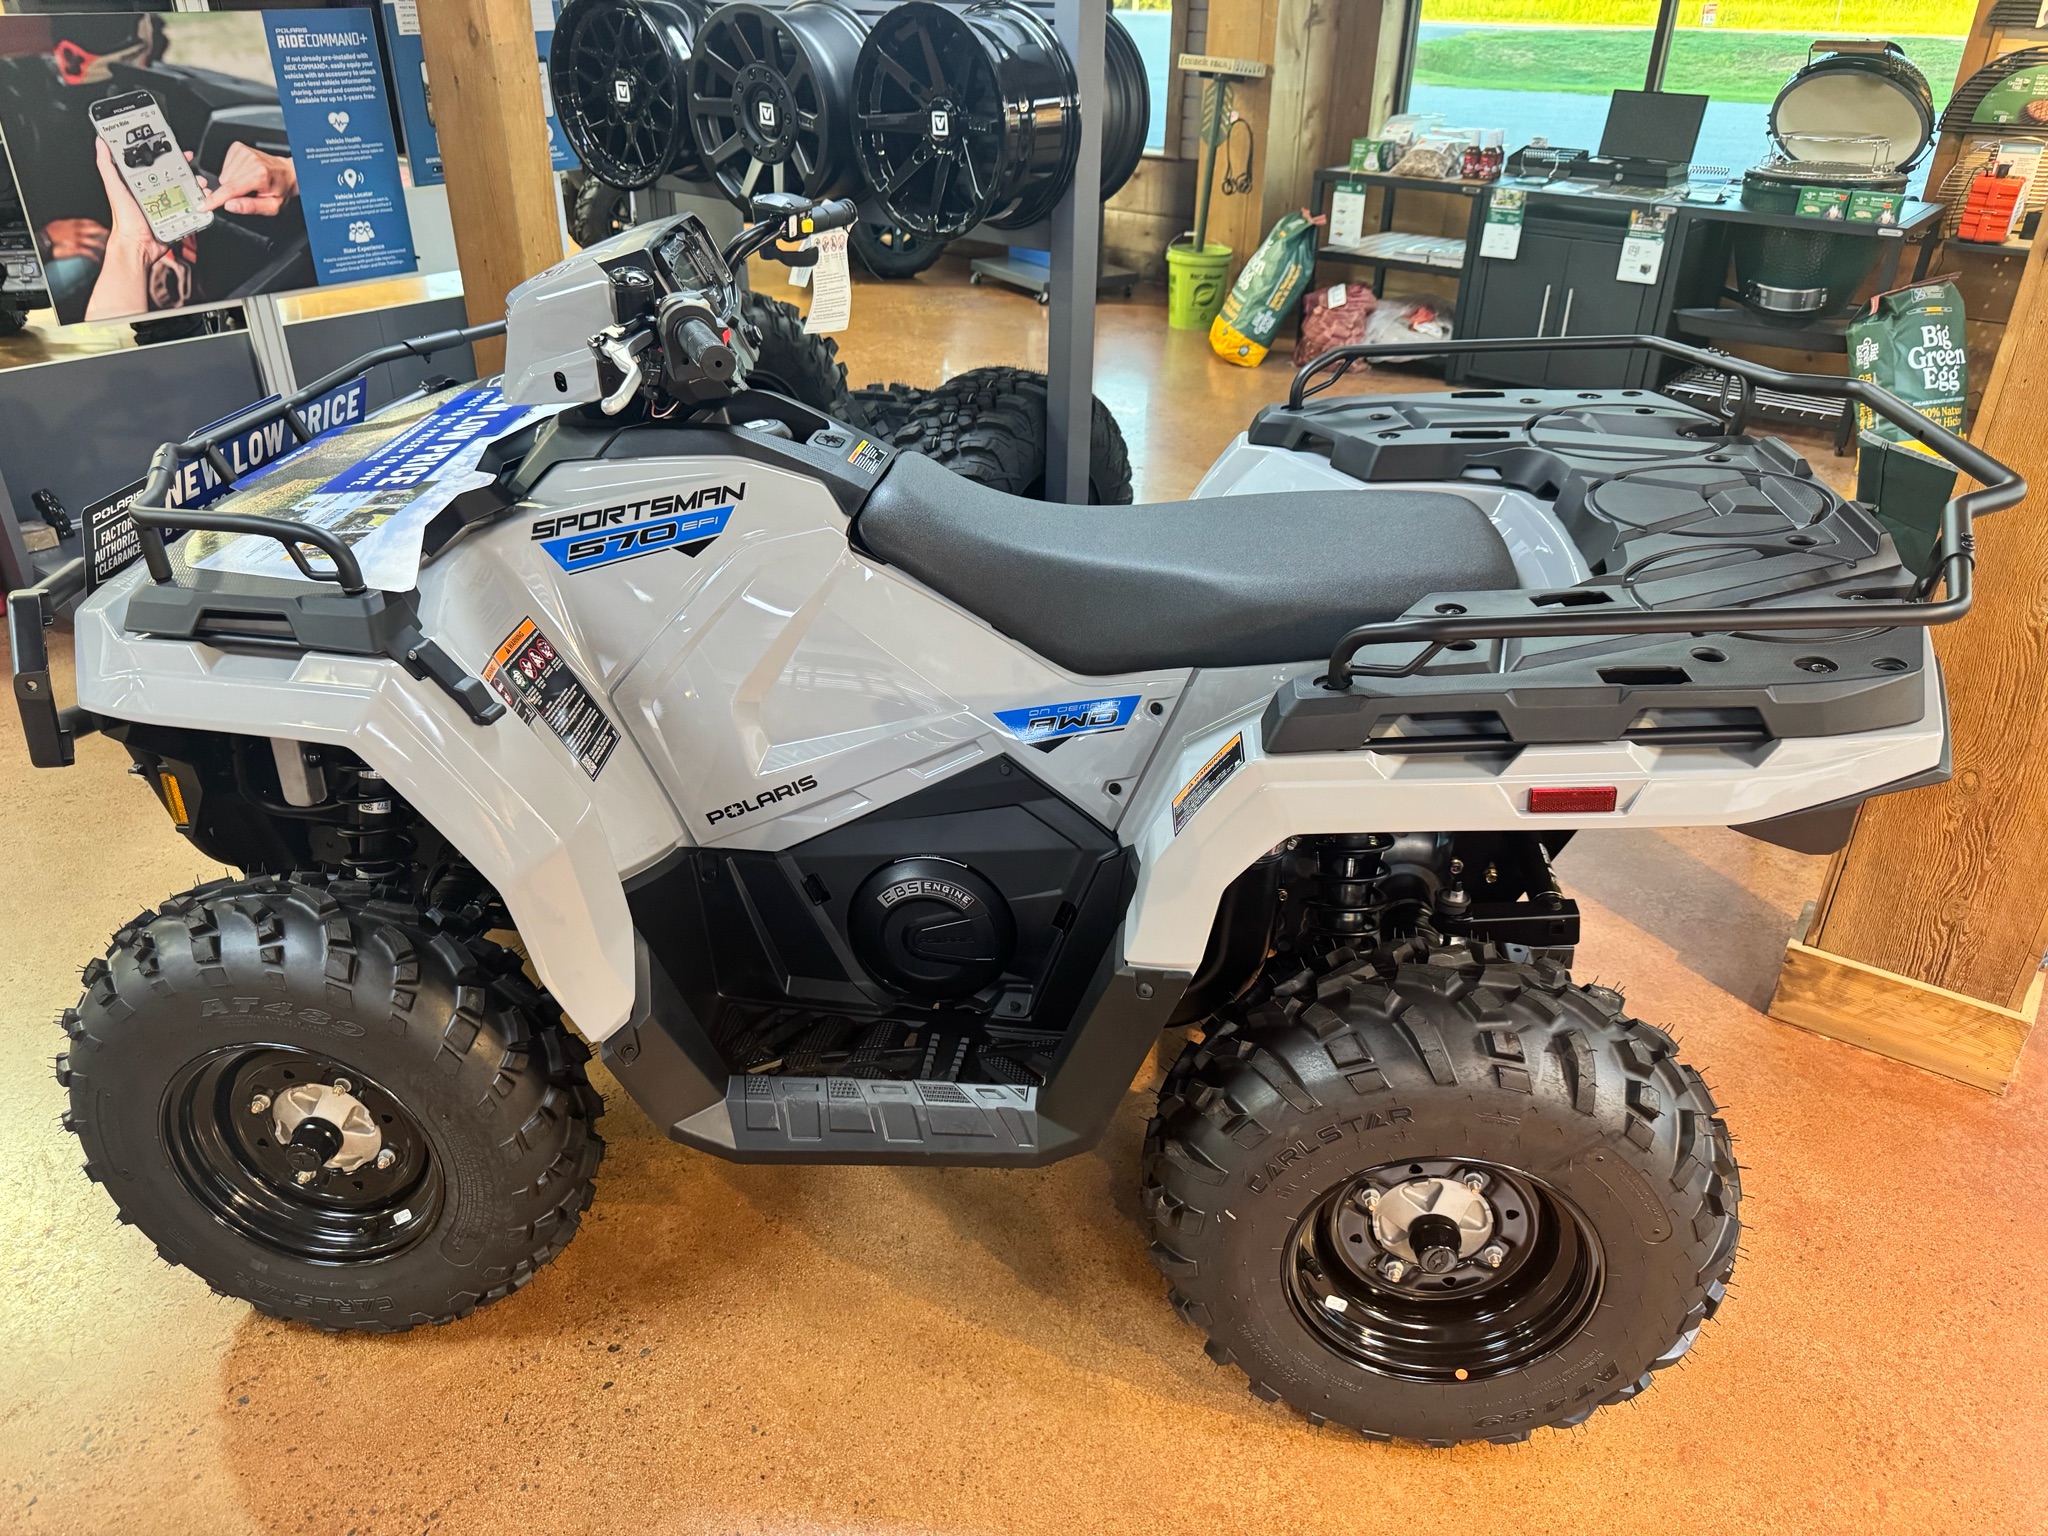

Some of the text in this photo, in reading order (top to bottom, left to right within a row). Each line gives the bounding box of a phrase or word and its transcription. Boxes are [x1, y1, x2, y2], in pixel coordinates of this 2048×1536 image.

[112, 104, 136, 114] POLARIS
[120, 120, 130, 128] Ride
[357, 244, 384, 252] Experience
[1921, 324, 1952, 350] Big
[1863, 337, 1872, 370] Green
[1870, 342, 1878, 362] Big
[1908, 346, 1966, 371] Green
[1924, 365, 1960, 392] Egg
[1918, 407, 1940, 418] 00%
[438, 413, 500, 441] LOW
[232, 419, 285, 474] LOW
[398, 429, 440, 453] PRICED
[374, 442, 461, 486] PRICE
[382, 454, 406, 464] TO
[346, 466, 390, 488] MOVE.
[531, 482, 746, 541] SPORTSMAN
[101, 518, 133, 546] FACTOR
[567, 516, 718, 562] 570 EFI
[95, 529, 139, 566] AUTHORIZ
[99, 542, 142, 576] CLEARANCE
[508, 630, 525, 650] WARNING
[1058, 700, 1121, 713] DEMAND
[1026, 708, 1120, 735] AWD
[1194, 752, 1223, 782] WARNING
[706, 774, 818, 826] POLARIS
[882, 882, 970, 904] EBS ENGINE
[200, 996, 366, 1037] AT489
[1245, 1106, 1416, 1196] CARLSTAR
[234, 1270, 396, 1314] CARLSTAR
[1471, 1359, 1621, 1430] AT489
